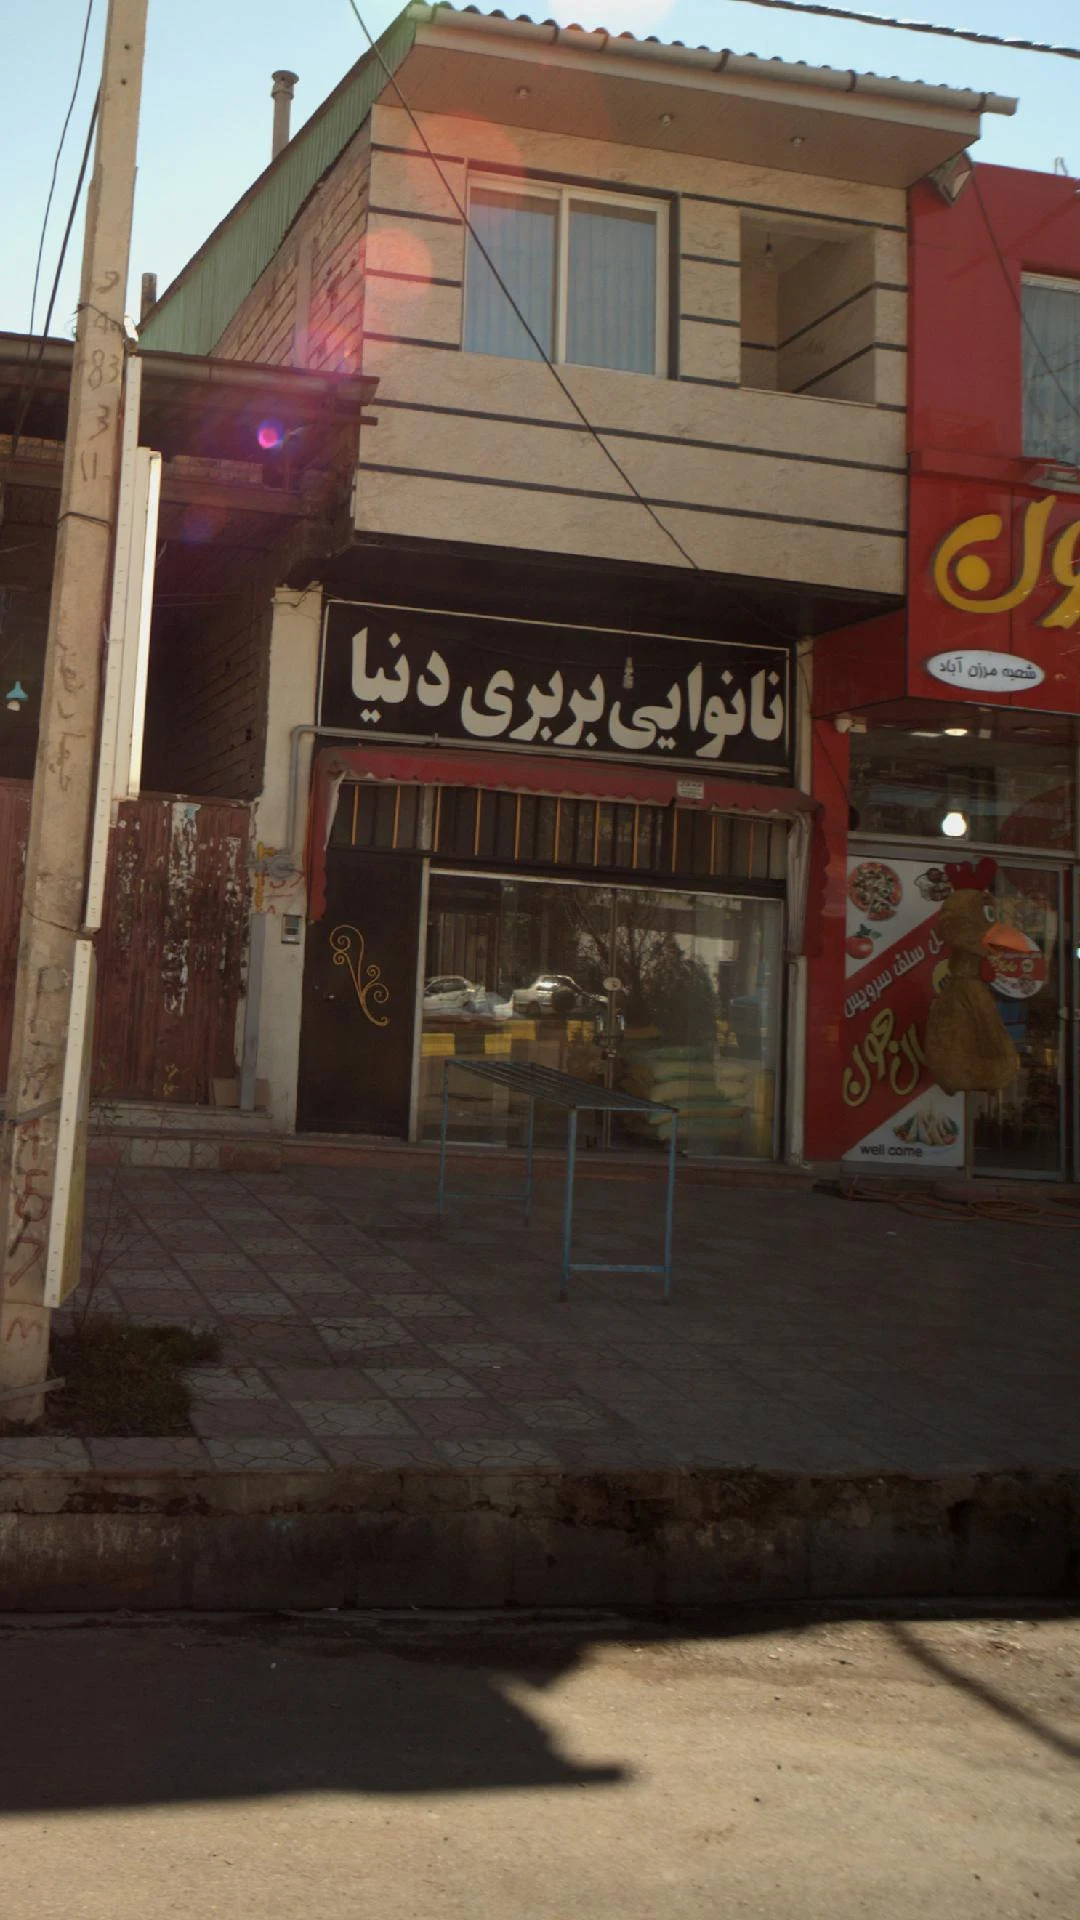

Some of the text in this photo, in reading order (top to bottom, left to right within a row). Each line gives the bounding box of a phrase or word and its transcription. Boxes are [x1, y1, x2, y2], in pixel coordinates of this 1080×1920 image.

[939, 656, 1036, 682] شعبه مرزن آباد
[351, 626, 784, 758] نانوایی بربری دنیا
[860, 1144, 924, 1158] well come
